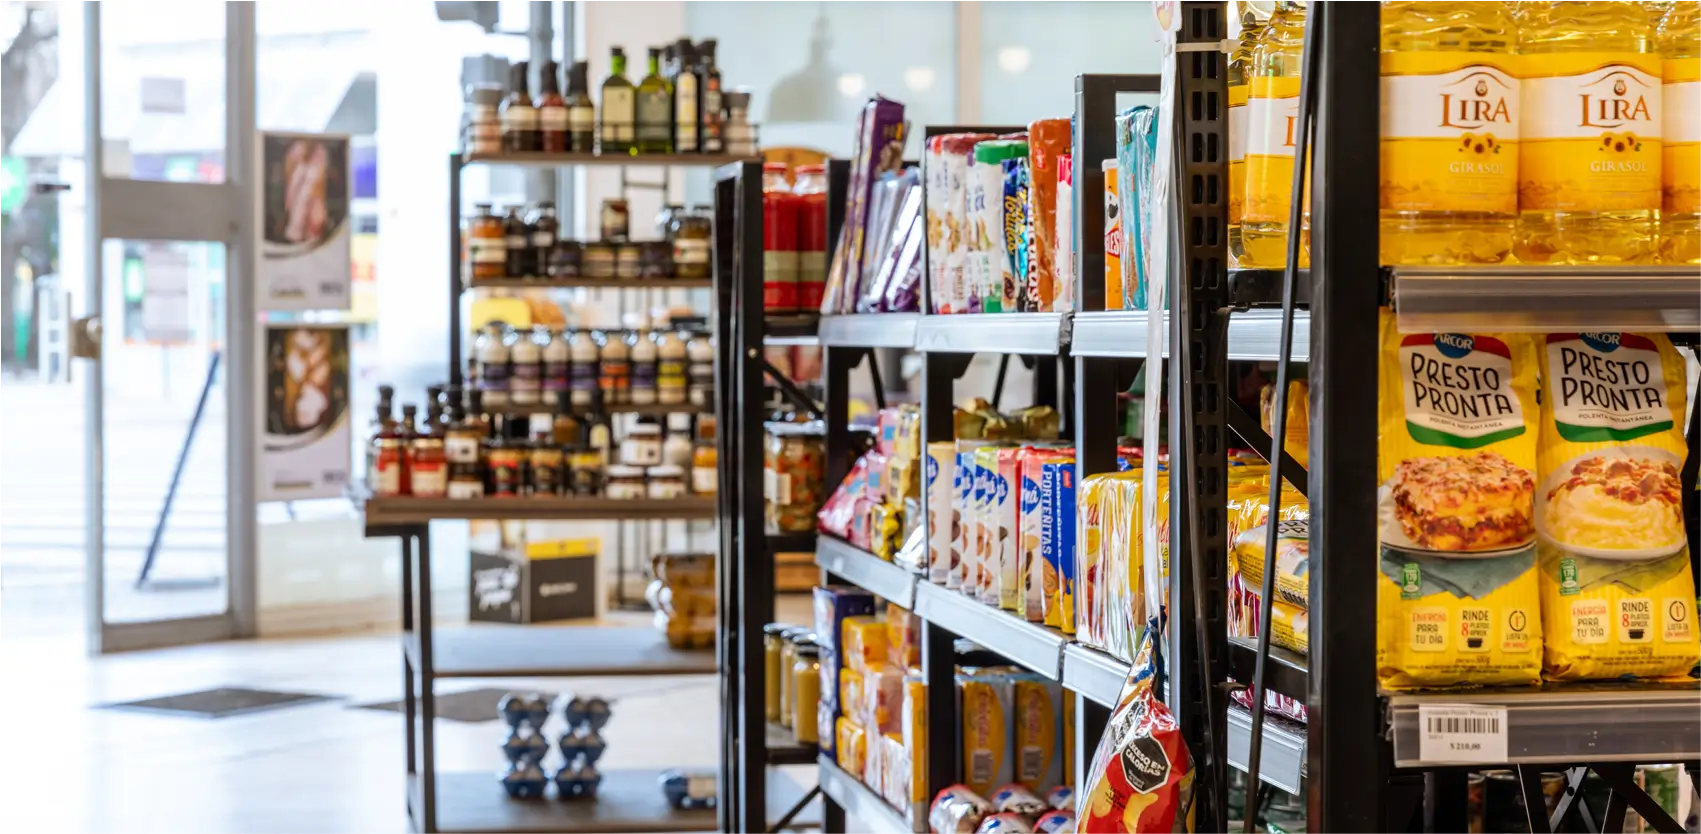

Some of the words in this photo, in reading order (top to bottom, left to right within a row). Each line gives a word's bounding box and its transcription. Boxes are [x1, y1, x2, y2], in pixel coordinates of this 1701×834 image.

[1438, 93, 1512, 129] LIRA
[1578, 93, 1652, 128] LIRA
[1449, 162, 1504, 174] GIRASOL
[1590, 160, 1647, 173] GIRASOL
[1411, 352, 1499, 391] PRESTO
[1561, 347, 1649, 385] PRESTO
[1413, 381, 1513, 418] PRONTA
[1561, 377, 1662, 411] PRONTA
[1042, 471, 1054, 555] PORTEÑITAS
[1621, 602, 1649, 612] RINDE
[1462, 610, 1489, 621] RINDE
[1578, 617, 1599, 626] PARA
[1622, 613, 1630, 627] 8
[1416, 624, 1438, 633] PARA
[1461, 622, 1469, 637] 8
[1577, 628, 1587, 637] TU
[1416, 635, 1426, 644] TU
[1125, 748, 1161, 777] CALORÍAS
[1128, 740, 1151, 765] EXCESO
[1150, 760, 1165, 771] EN
